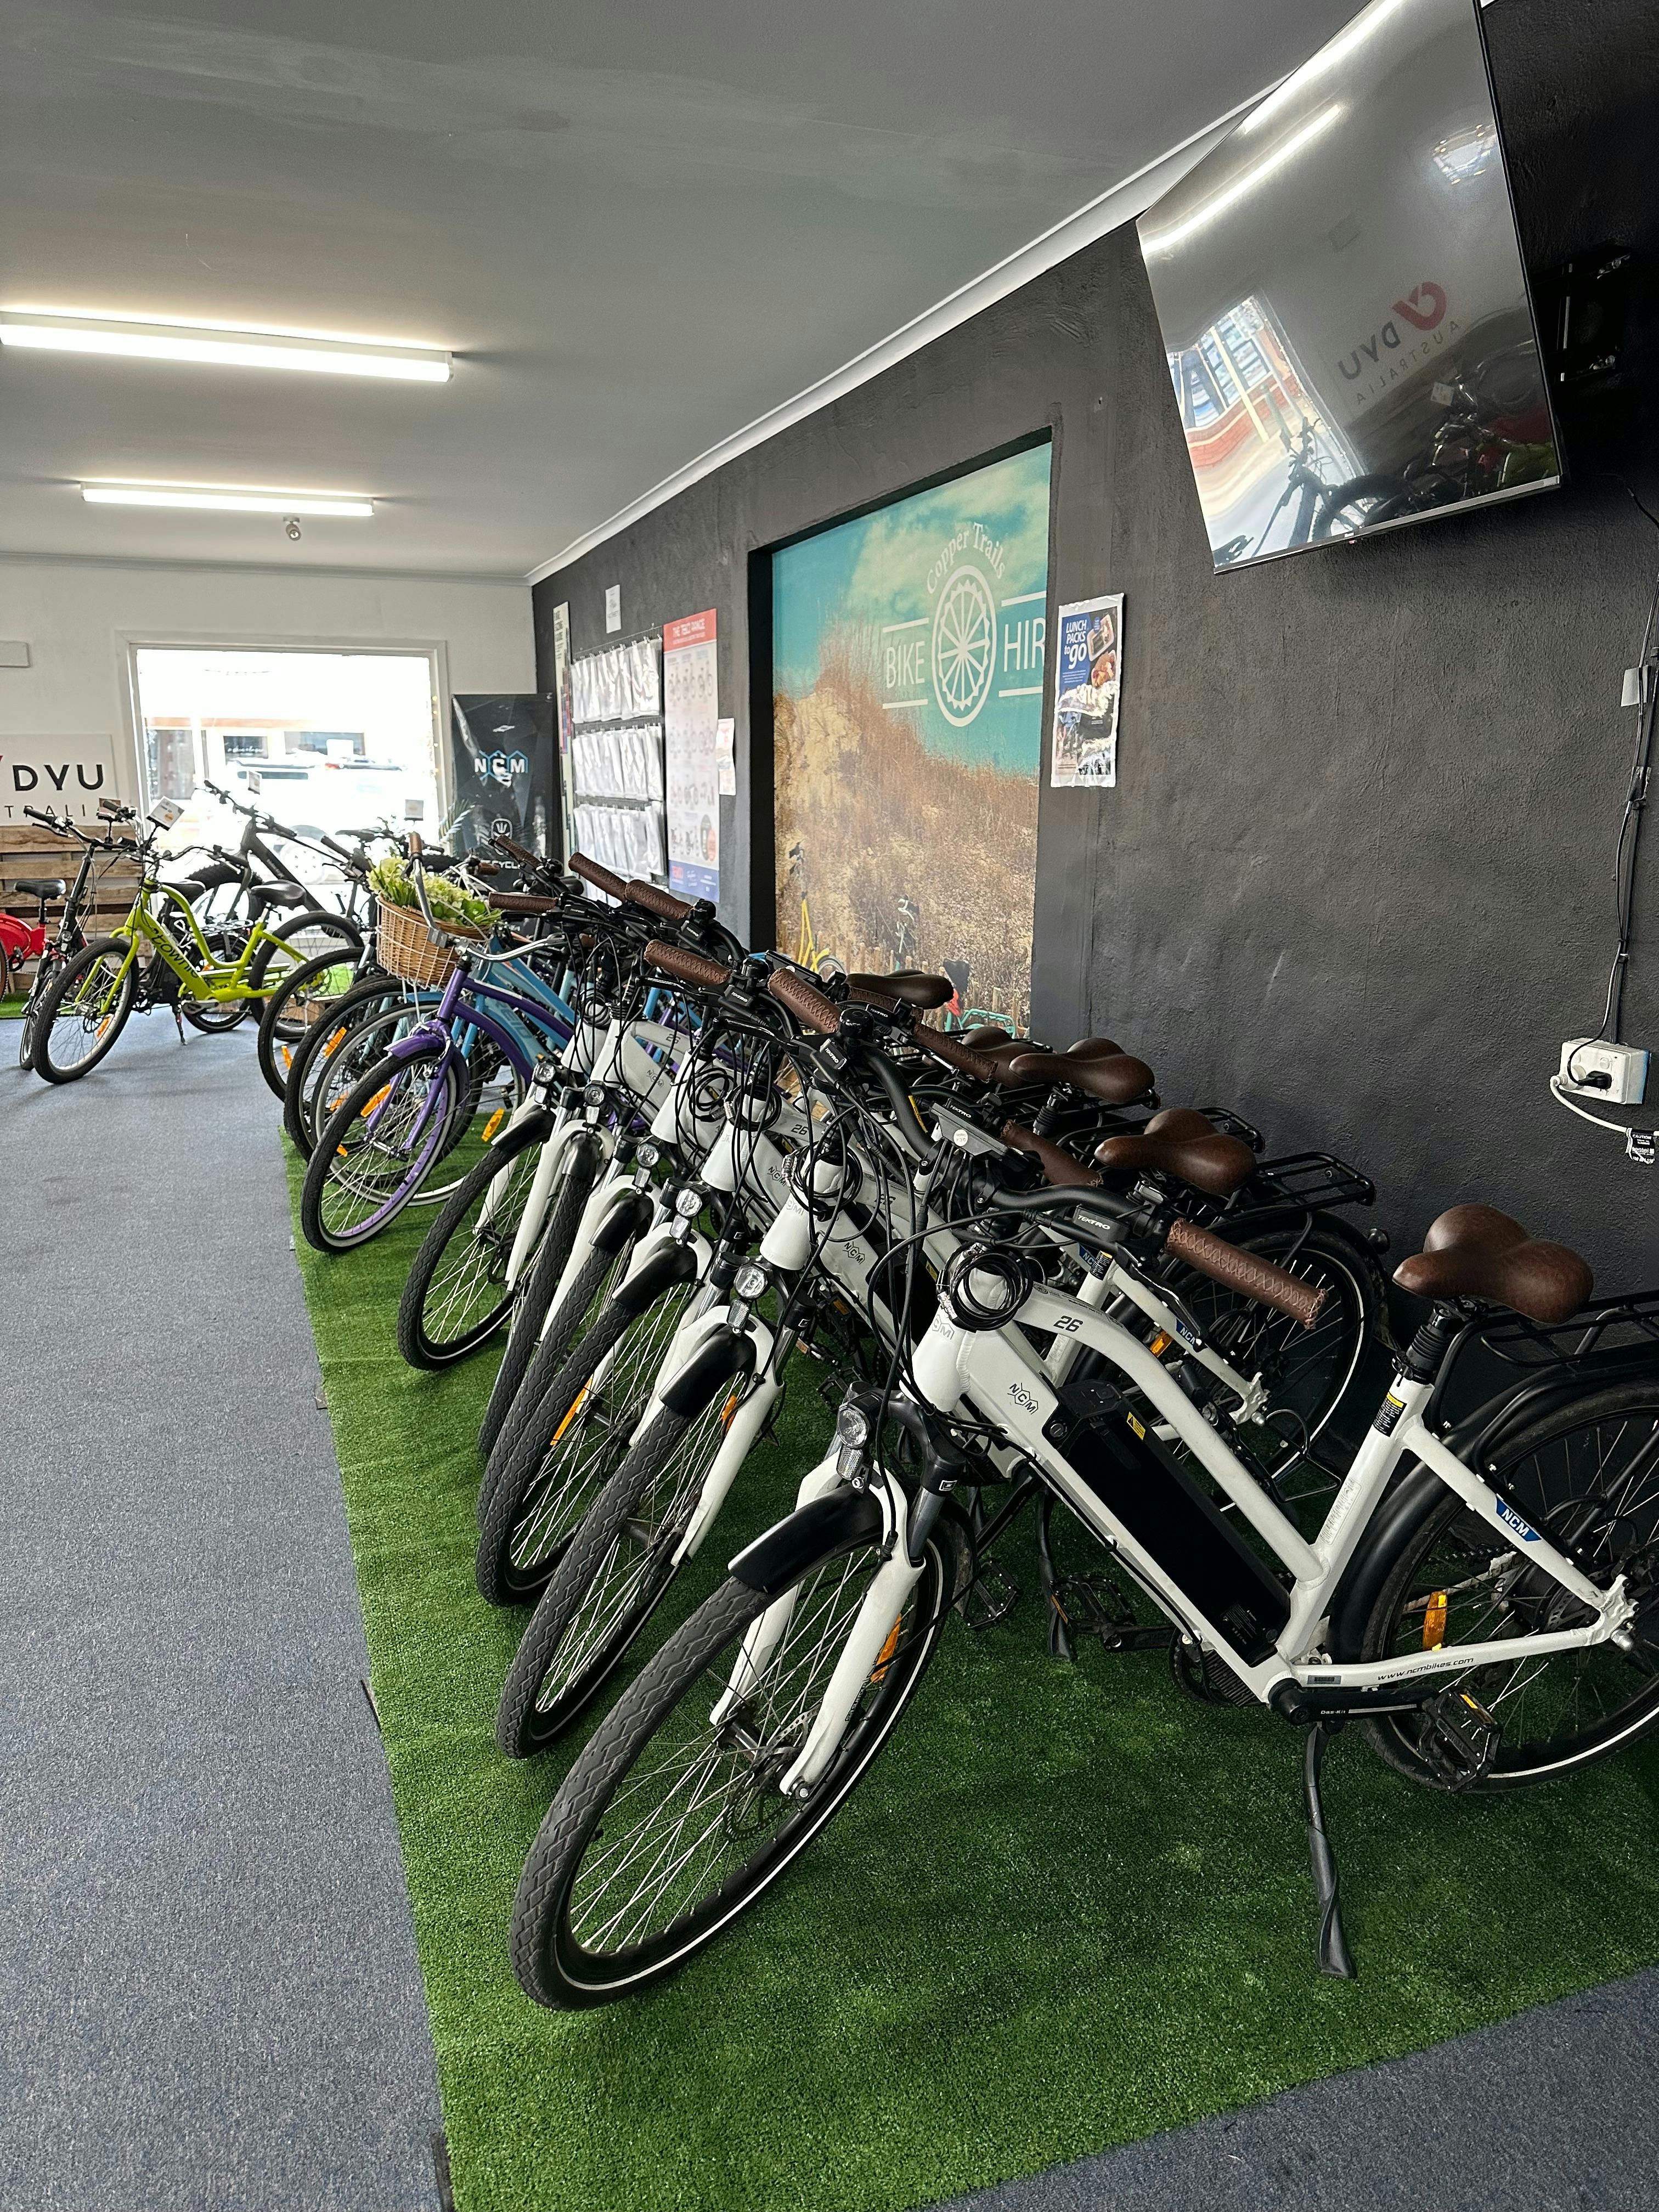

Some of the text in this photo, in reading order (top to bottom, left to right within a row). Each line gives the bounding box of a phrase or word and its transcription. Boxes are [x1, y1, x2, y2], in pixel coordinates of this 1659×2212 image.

[927, 522, 1006, 594] Copper Trails
[1066, 619, 1087, 634] LUNCH
[1066, 631, 1086, 645] PACKS
[885, 617, 1046, 689] BIKE HIR
[1064, 643, 1087, 670] to go
[474, 758, 526, 774] NCM
[12, 764, 104, 791] DYU
[4, 804, 86, 818] TRALI
[791, 1124, 809, 1135] 26
[768, 1166, 787, 1187] NCM
[1078, 1215, 1110, 1230] TEKTRO
[843, 1242, 864, 1265] NCM
[1082, 1252, 1095, 1265] NC
[932, 1316, 954, 1340] CM
[1053, 1315, 1084, 1332] 26
[1008, 1383, 1039, 1415] NCM
[1501, 1508, 1530, 1537] NCM
[1378, 1657, 1474, 1680] www.ncmbikes.com
